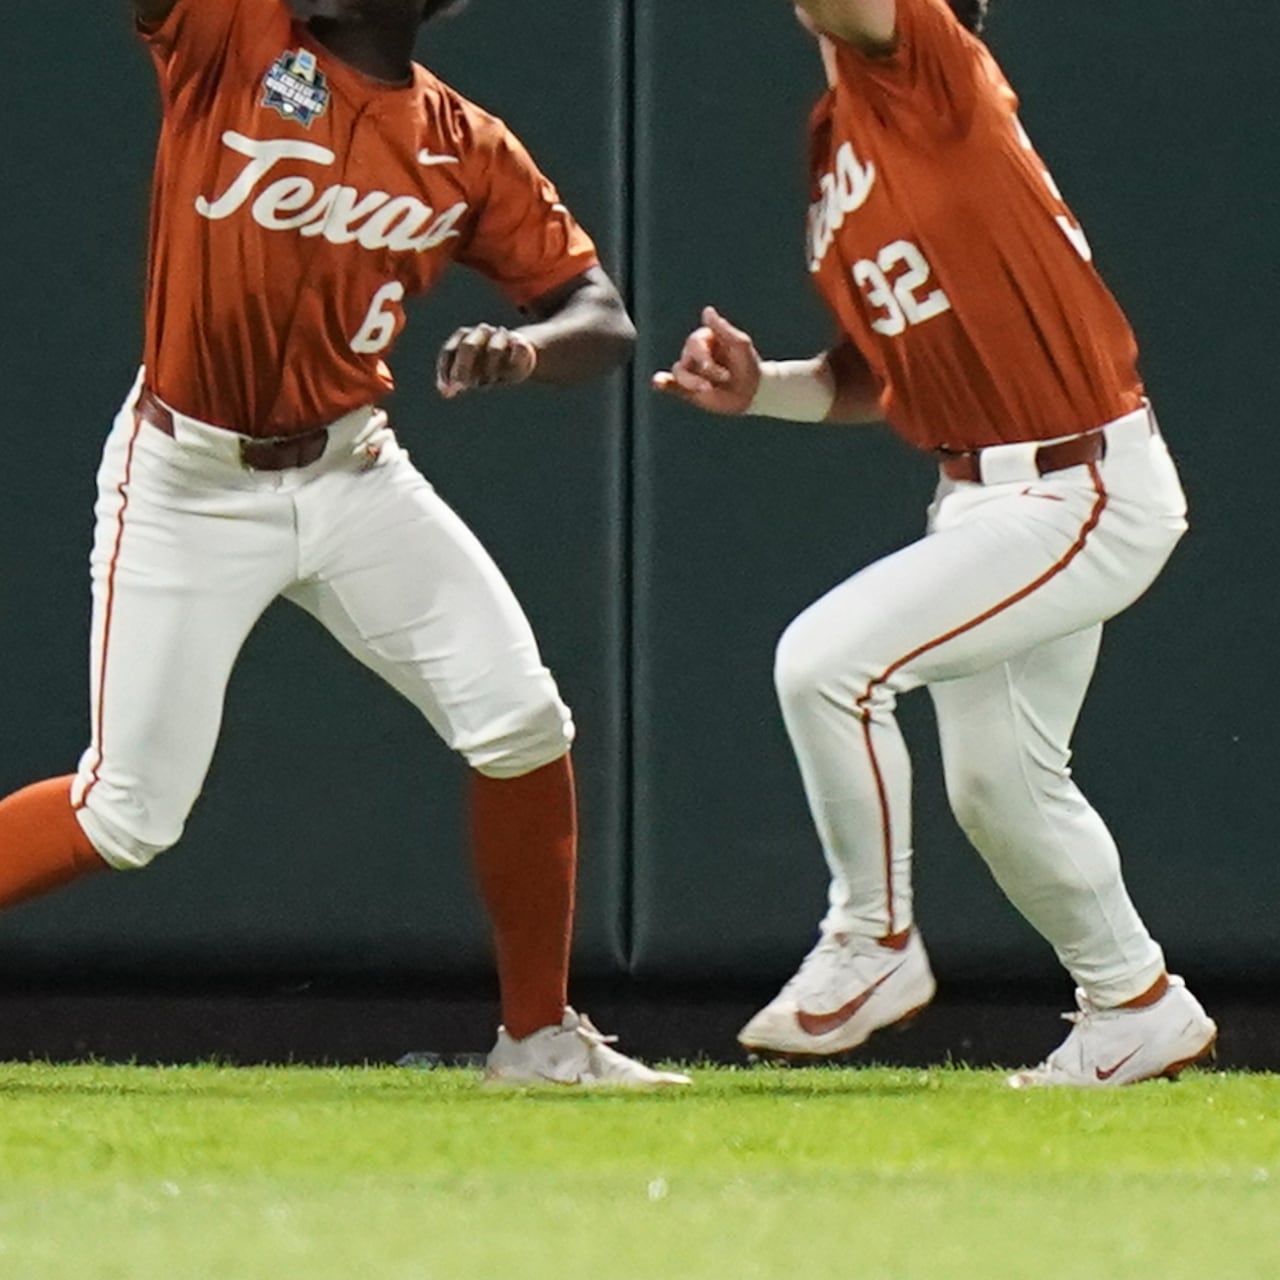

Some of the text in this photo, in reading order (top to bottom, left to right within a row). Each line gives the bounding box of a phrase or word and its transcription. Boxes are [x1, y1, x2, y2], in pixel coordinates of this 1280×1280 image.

[195, 130, 468, 252] Texas
[350, 281, 405, 354] 6
[852, 239, 951, 337] 32
